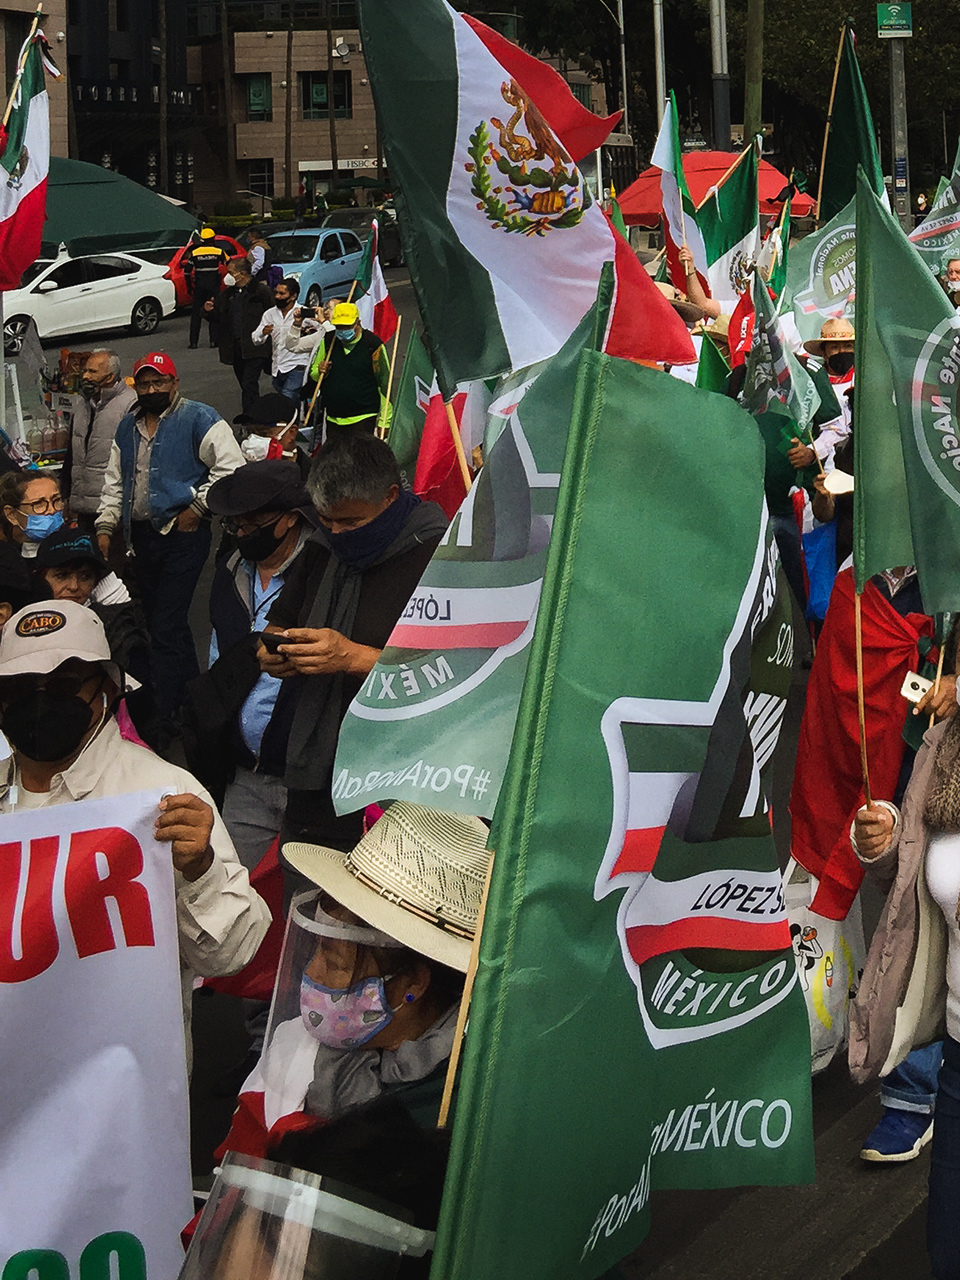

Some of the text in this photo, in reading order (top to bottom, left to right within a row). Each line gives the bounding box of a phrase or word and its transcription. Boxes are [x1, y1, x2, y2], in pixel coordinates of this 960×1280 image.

[77, 85, 138, 102] TORRE
[347, 160, 368, 168] HSBC
[21, 616, 61, 632] CABO
[0, 827, 156, 984] UR
[690, 877, 774, 915] LÓPEZ
[650, 959, 788, 1017] MÉXICO
